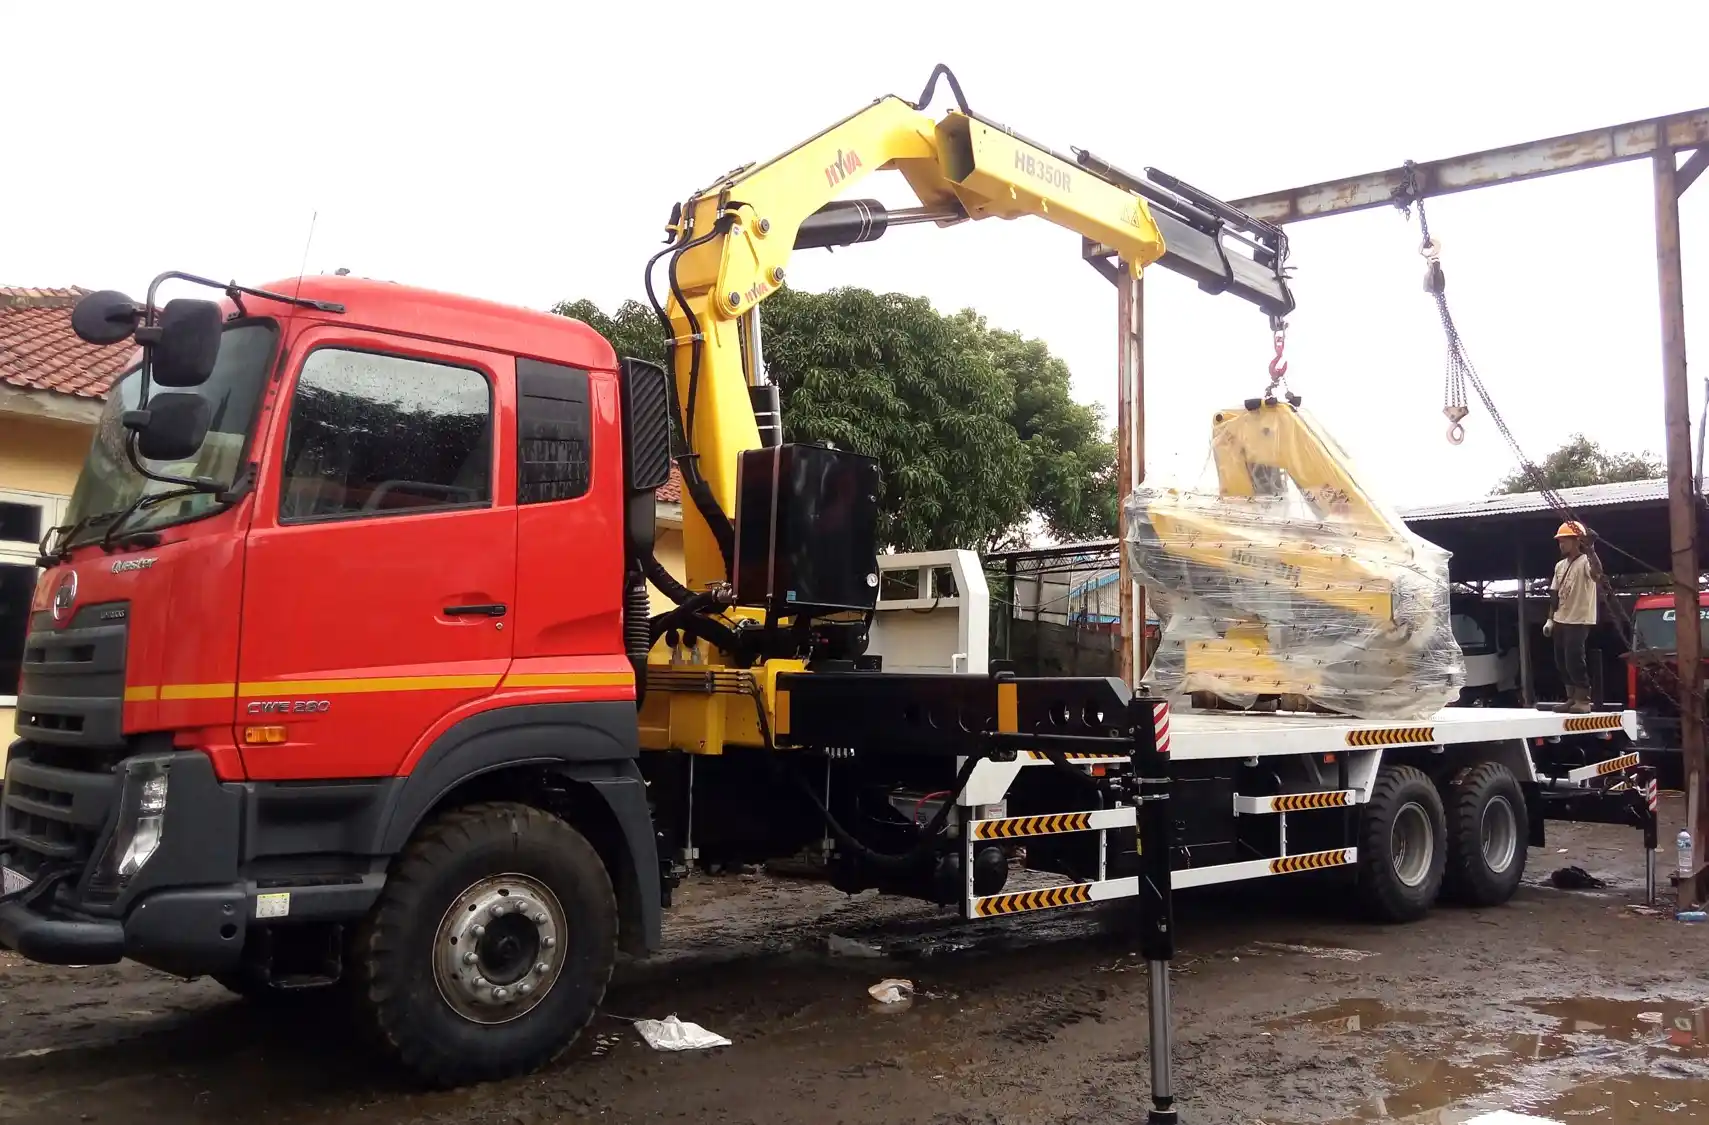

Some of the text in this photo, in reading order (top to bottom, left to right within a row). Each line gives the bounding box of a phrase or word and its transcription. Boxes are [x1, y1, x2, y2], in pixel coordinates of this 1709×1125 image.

[825, 149, 862, 188] HYVA
[1015, 149, 1071, 193] HB350R
[744, 282, 768, 303] HYVA
[111, 558, 159, 574] Quester
[247, 701, 291, 713] CWE
